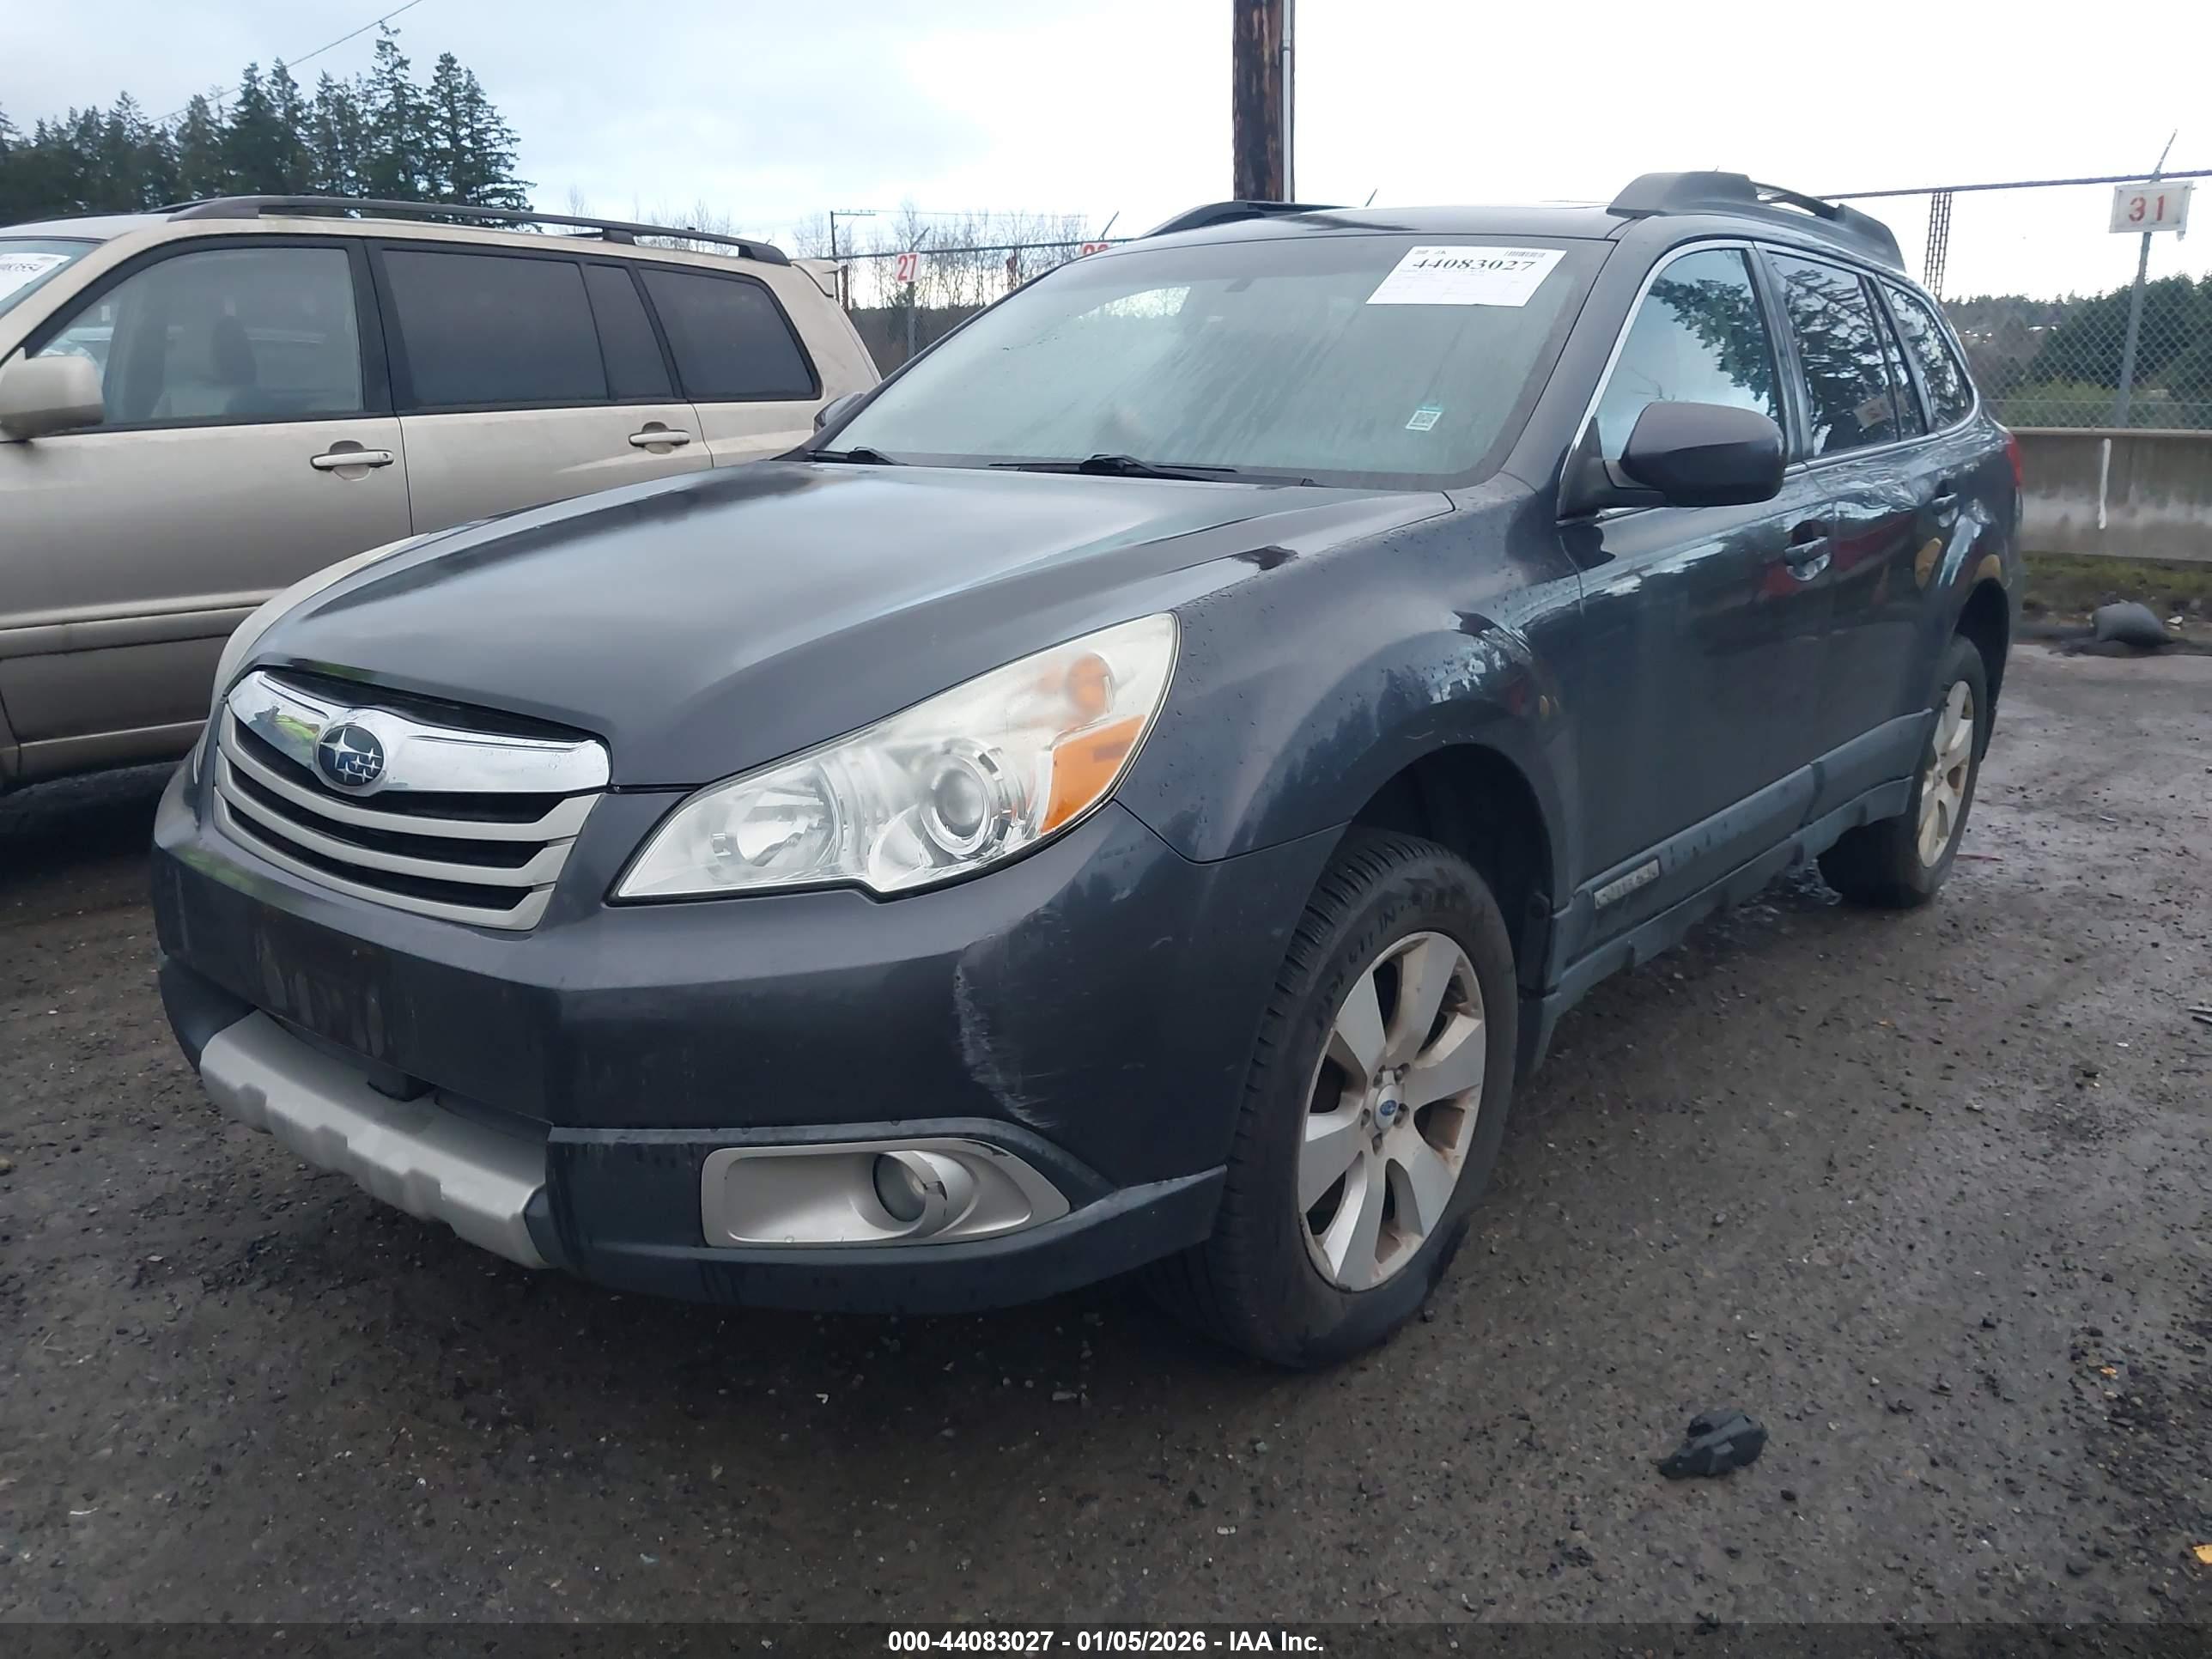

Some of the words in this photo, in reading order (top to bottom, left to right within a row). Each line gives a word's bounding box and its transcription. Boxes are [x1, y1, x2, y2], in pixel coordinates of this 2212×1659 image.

[2129, 194, 2165, 222] 31
[897, 254, 917, 281] 27
[1413, 258, 1536, 271] 44083027
